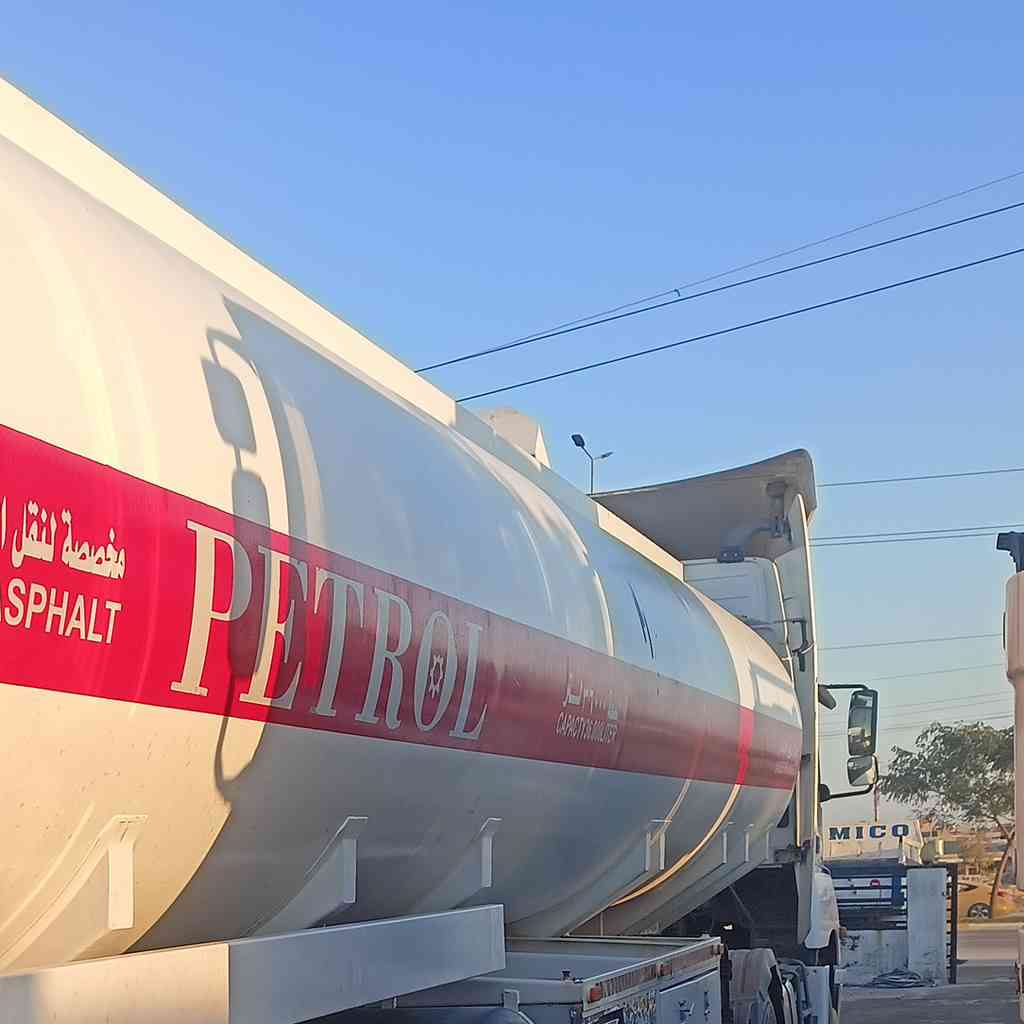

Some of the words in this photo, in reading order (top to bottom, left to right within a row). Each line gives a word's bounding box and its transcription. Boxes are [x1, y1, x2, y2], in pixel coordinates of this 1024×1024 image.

[10, 500, 58, 569] لنقل
[61, 507, 126, 580] مخصصة
[170, 519, 488, 740] PETROL
[828, 823, 911, 841] MICO
